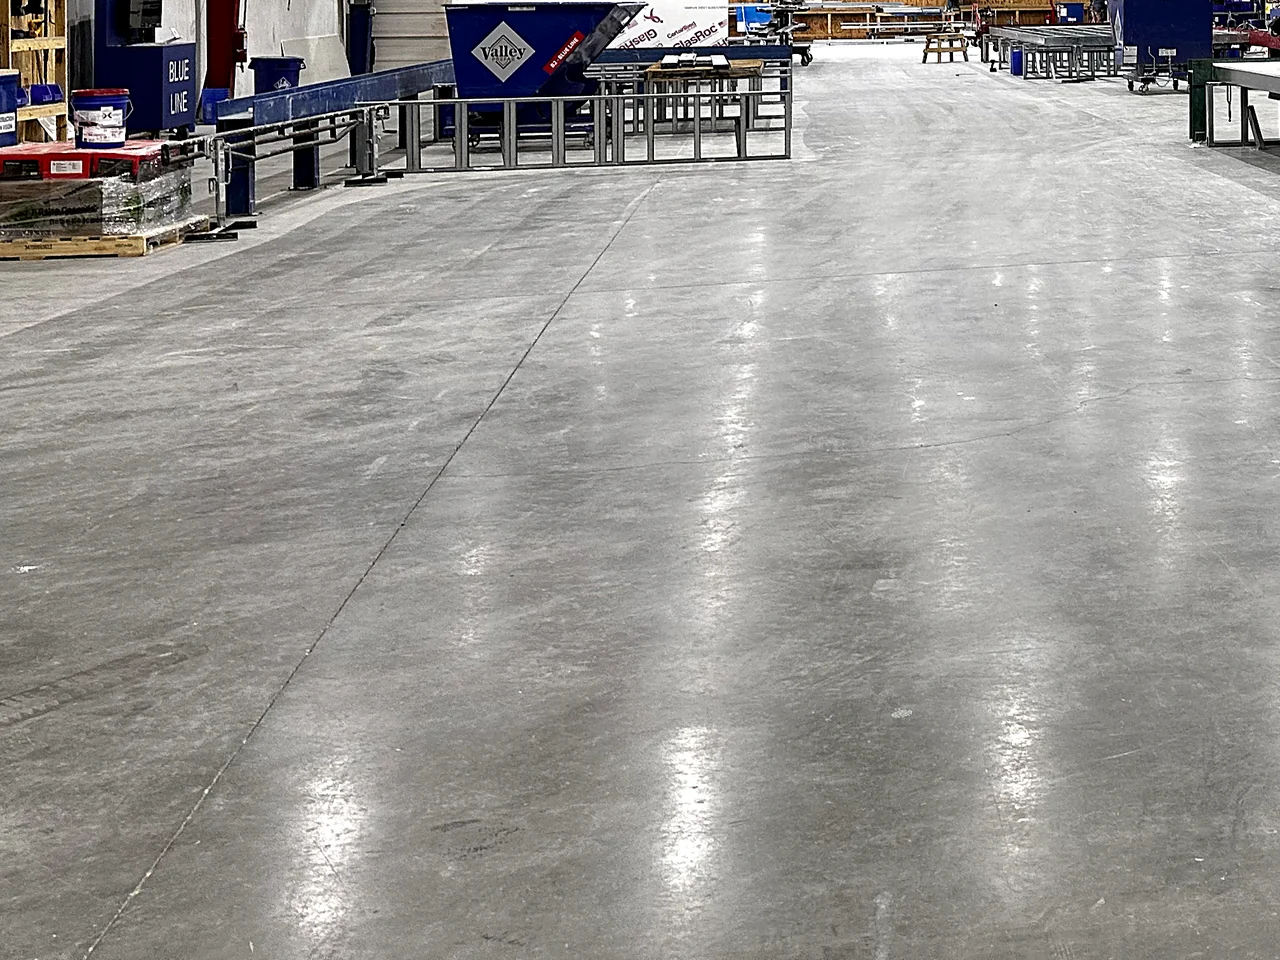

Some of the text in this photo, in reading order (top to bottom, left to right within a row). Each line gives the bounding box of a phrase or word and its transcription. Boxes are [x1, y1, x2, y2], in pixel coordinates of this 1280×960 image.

[480, 45, 526, 63] Valley
[567, 37, 579, 50] LINE
[169, 58, 190, 83] BLUE
[170, 90, 188, 115] LINE
